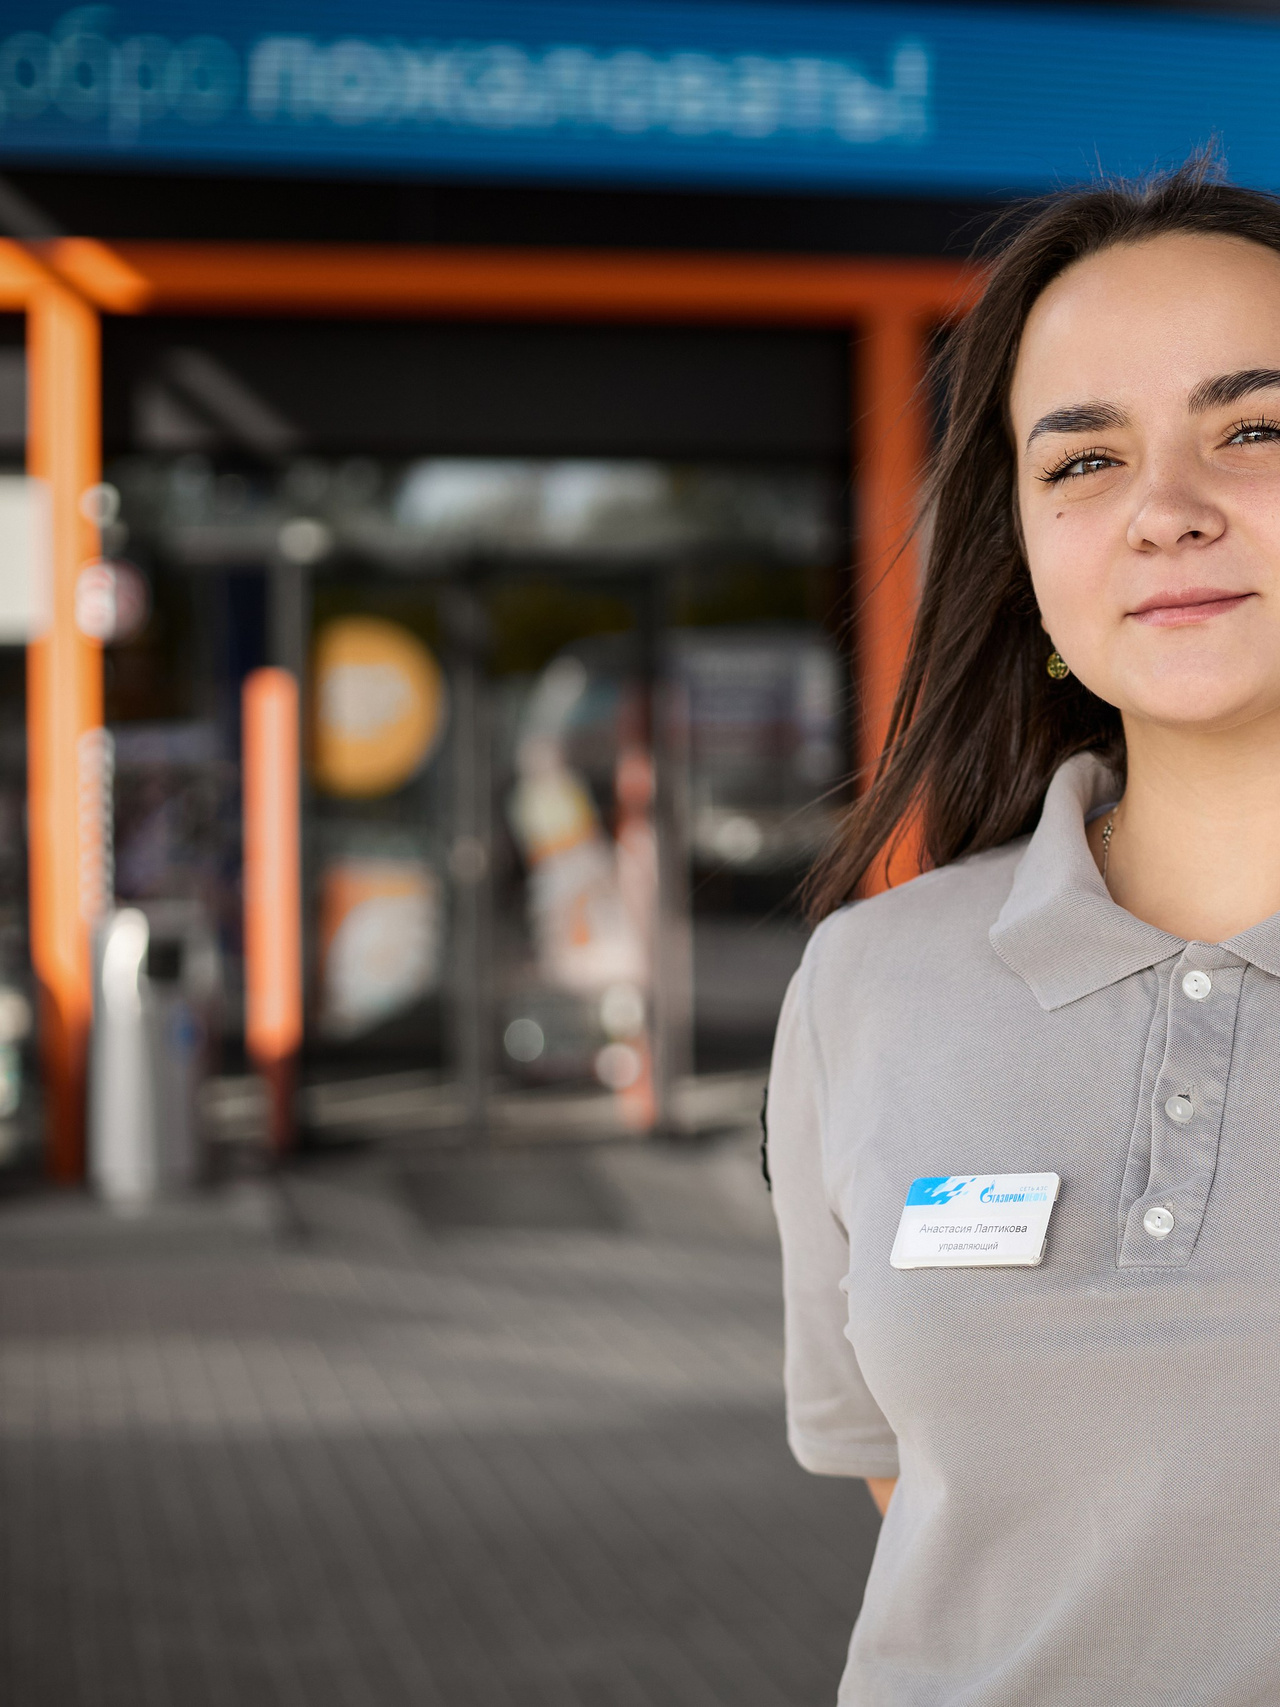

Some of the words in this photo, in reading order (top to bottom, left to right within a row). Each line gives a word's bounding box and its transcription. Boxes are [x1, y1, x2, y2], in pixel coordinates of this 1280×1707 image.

[248, 36, 930, 144] пожаловать!
[919, 1223, 973, 1234] Анастасия
[974, 1223, 1028, 1233] Лаптикова
[938, 1241, 999, 1252] управляющий
